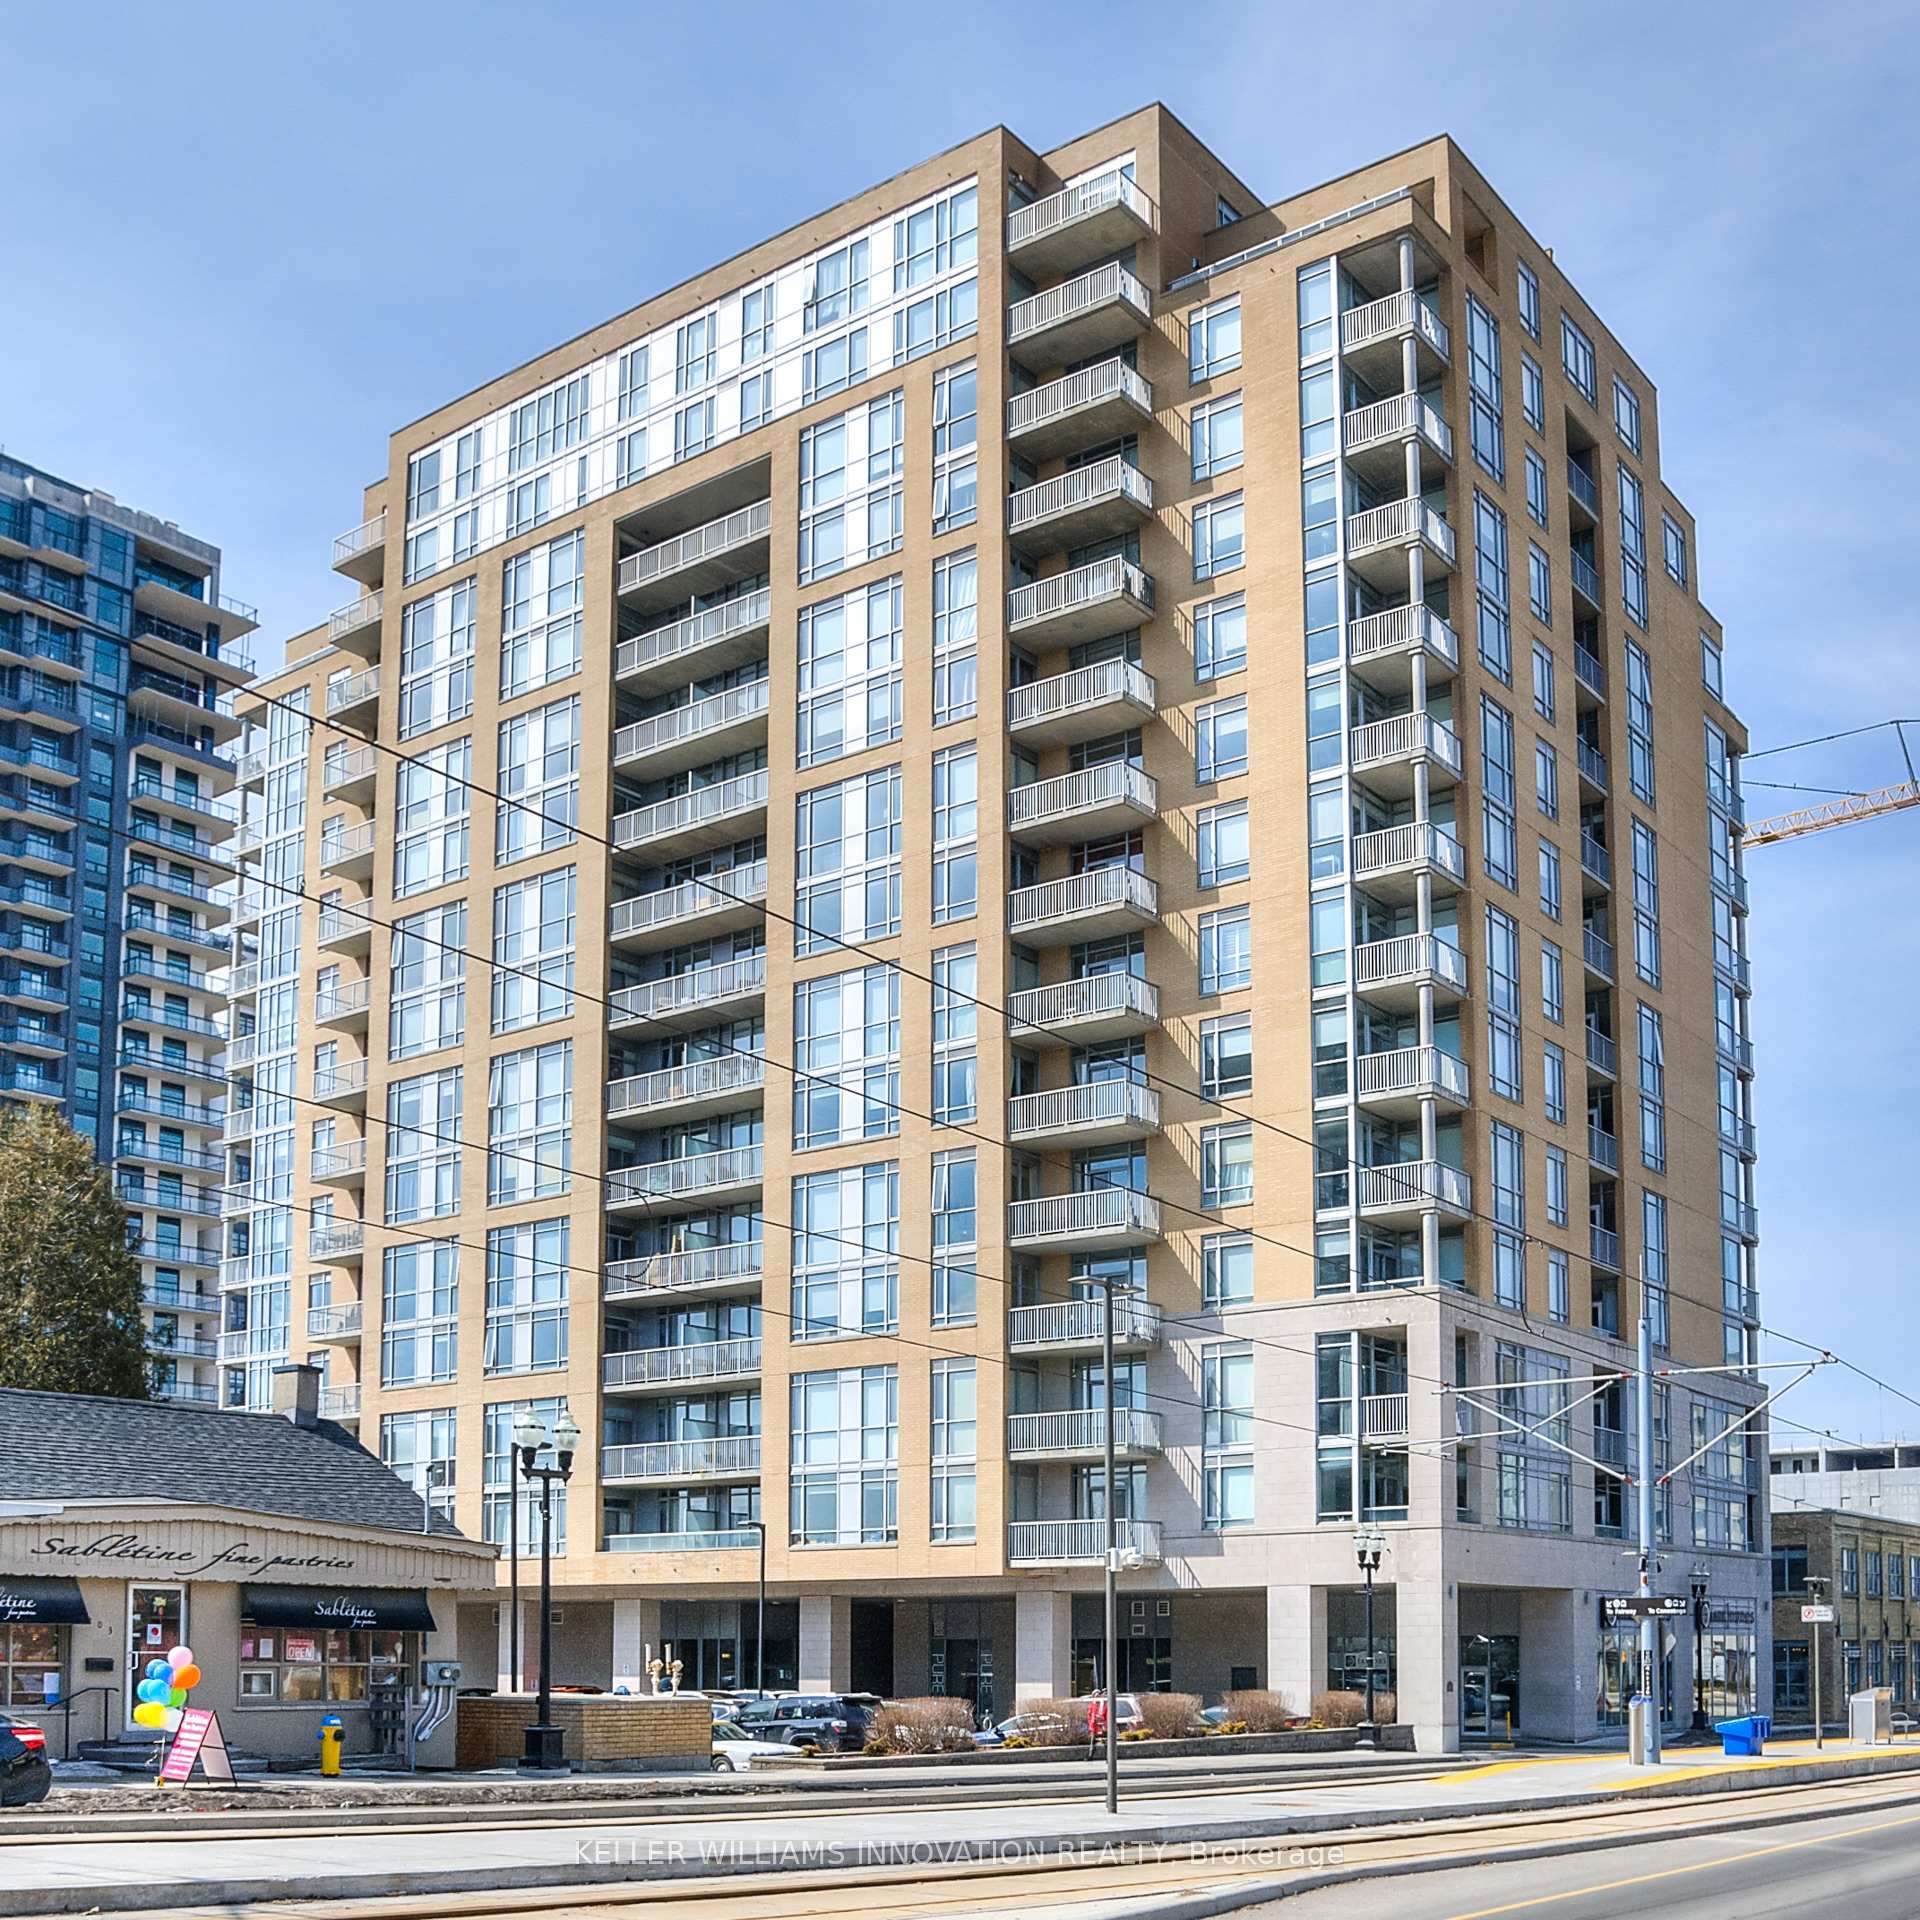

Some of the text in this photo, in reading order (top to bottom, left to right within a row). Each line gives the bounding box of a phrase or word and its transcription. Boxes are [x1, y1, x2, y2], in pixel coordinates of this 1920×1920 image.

[31, 1534, 355, 1576] Sablétine fine pastries
[288, 1646, 312, 1658] OPEN
[932, 1653, 944, 1693] PURE
[980, 1653, 993, 1693] PURE
